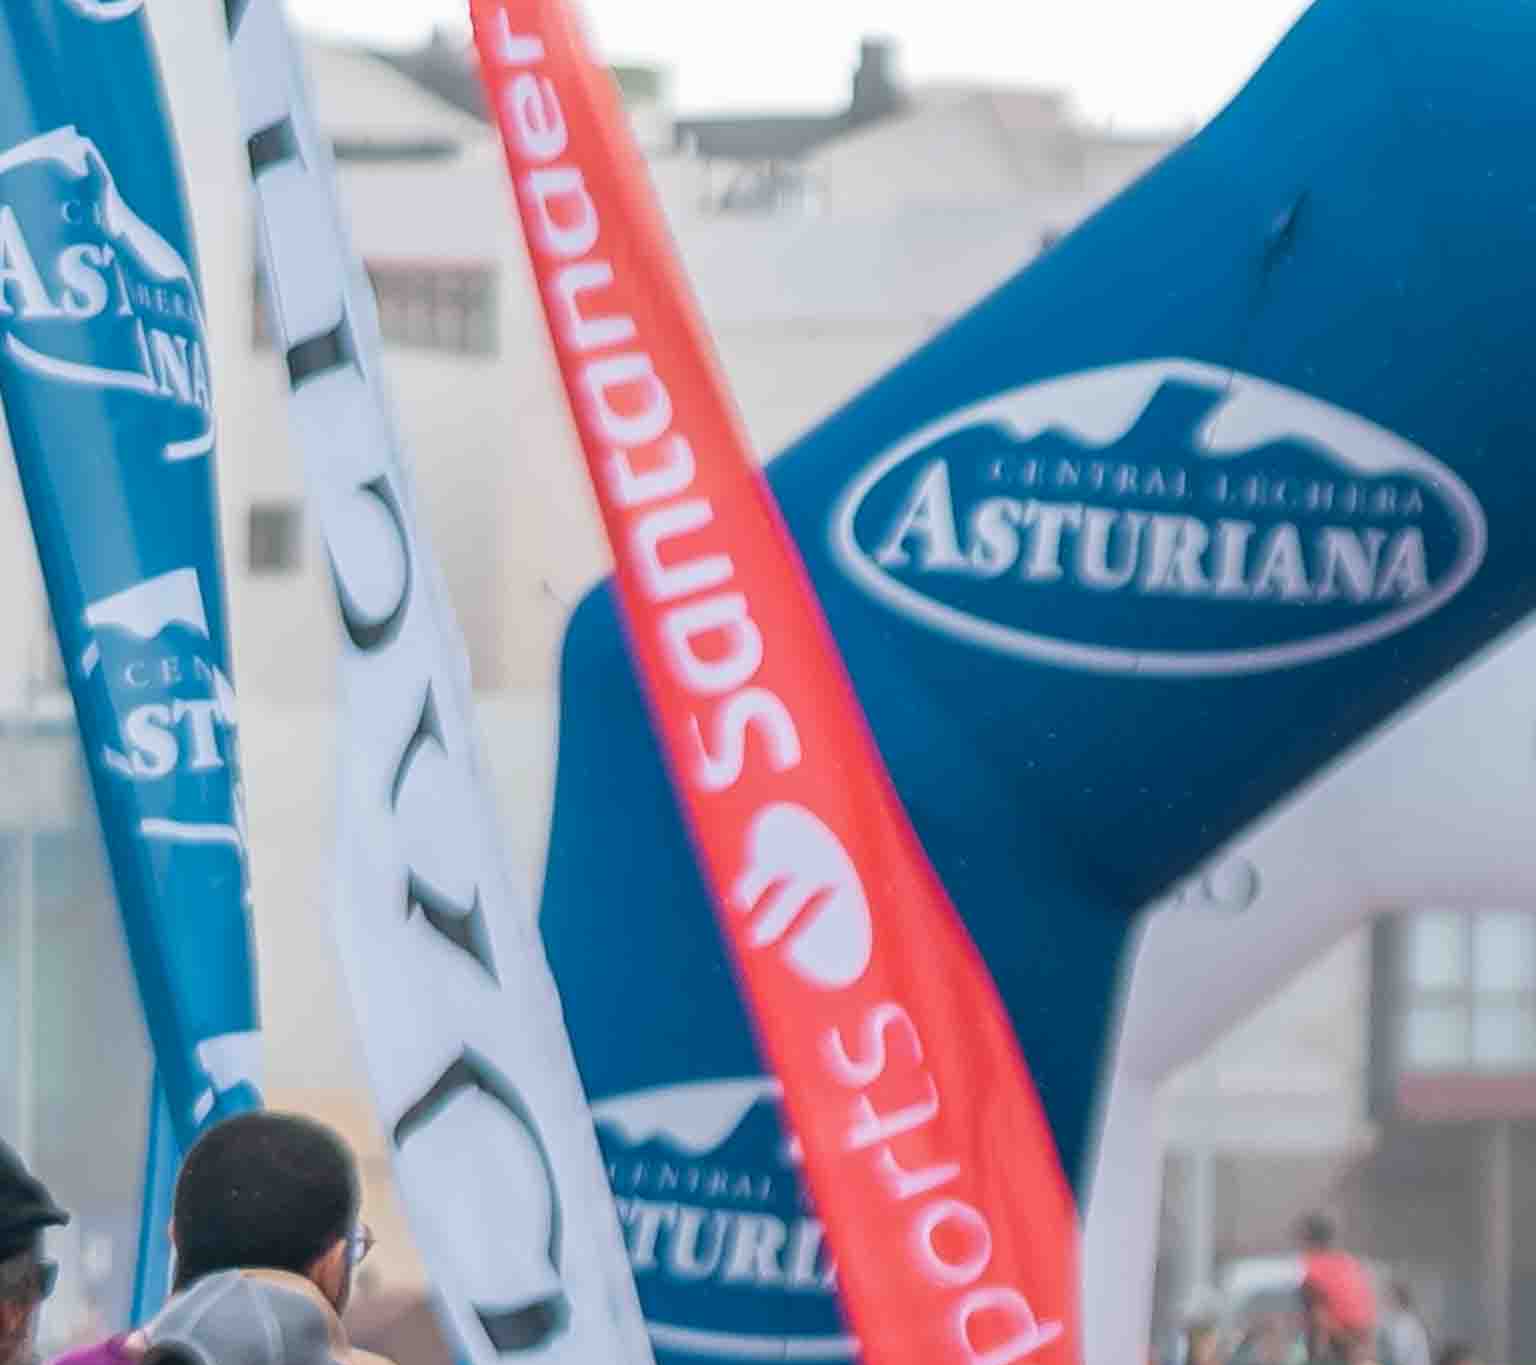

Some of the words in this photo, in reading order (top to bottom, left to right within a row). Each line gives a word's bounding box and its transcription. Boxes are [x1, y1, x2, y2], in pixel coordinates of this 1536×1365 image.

[873, 456, 1432, 601] ASTURIANA
[985, 458, 1192, 499] CENTRAL
[1213, 468, 1426, 515] LECHERA
